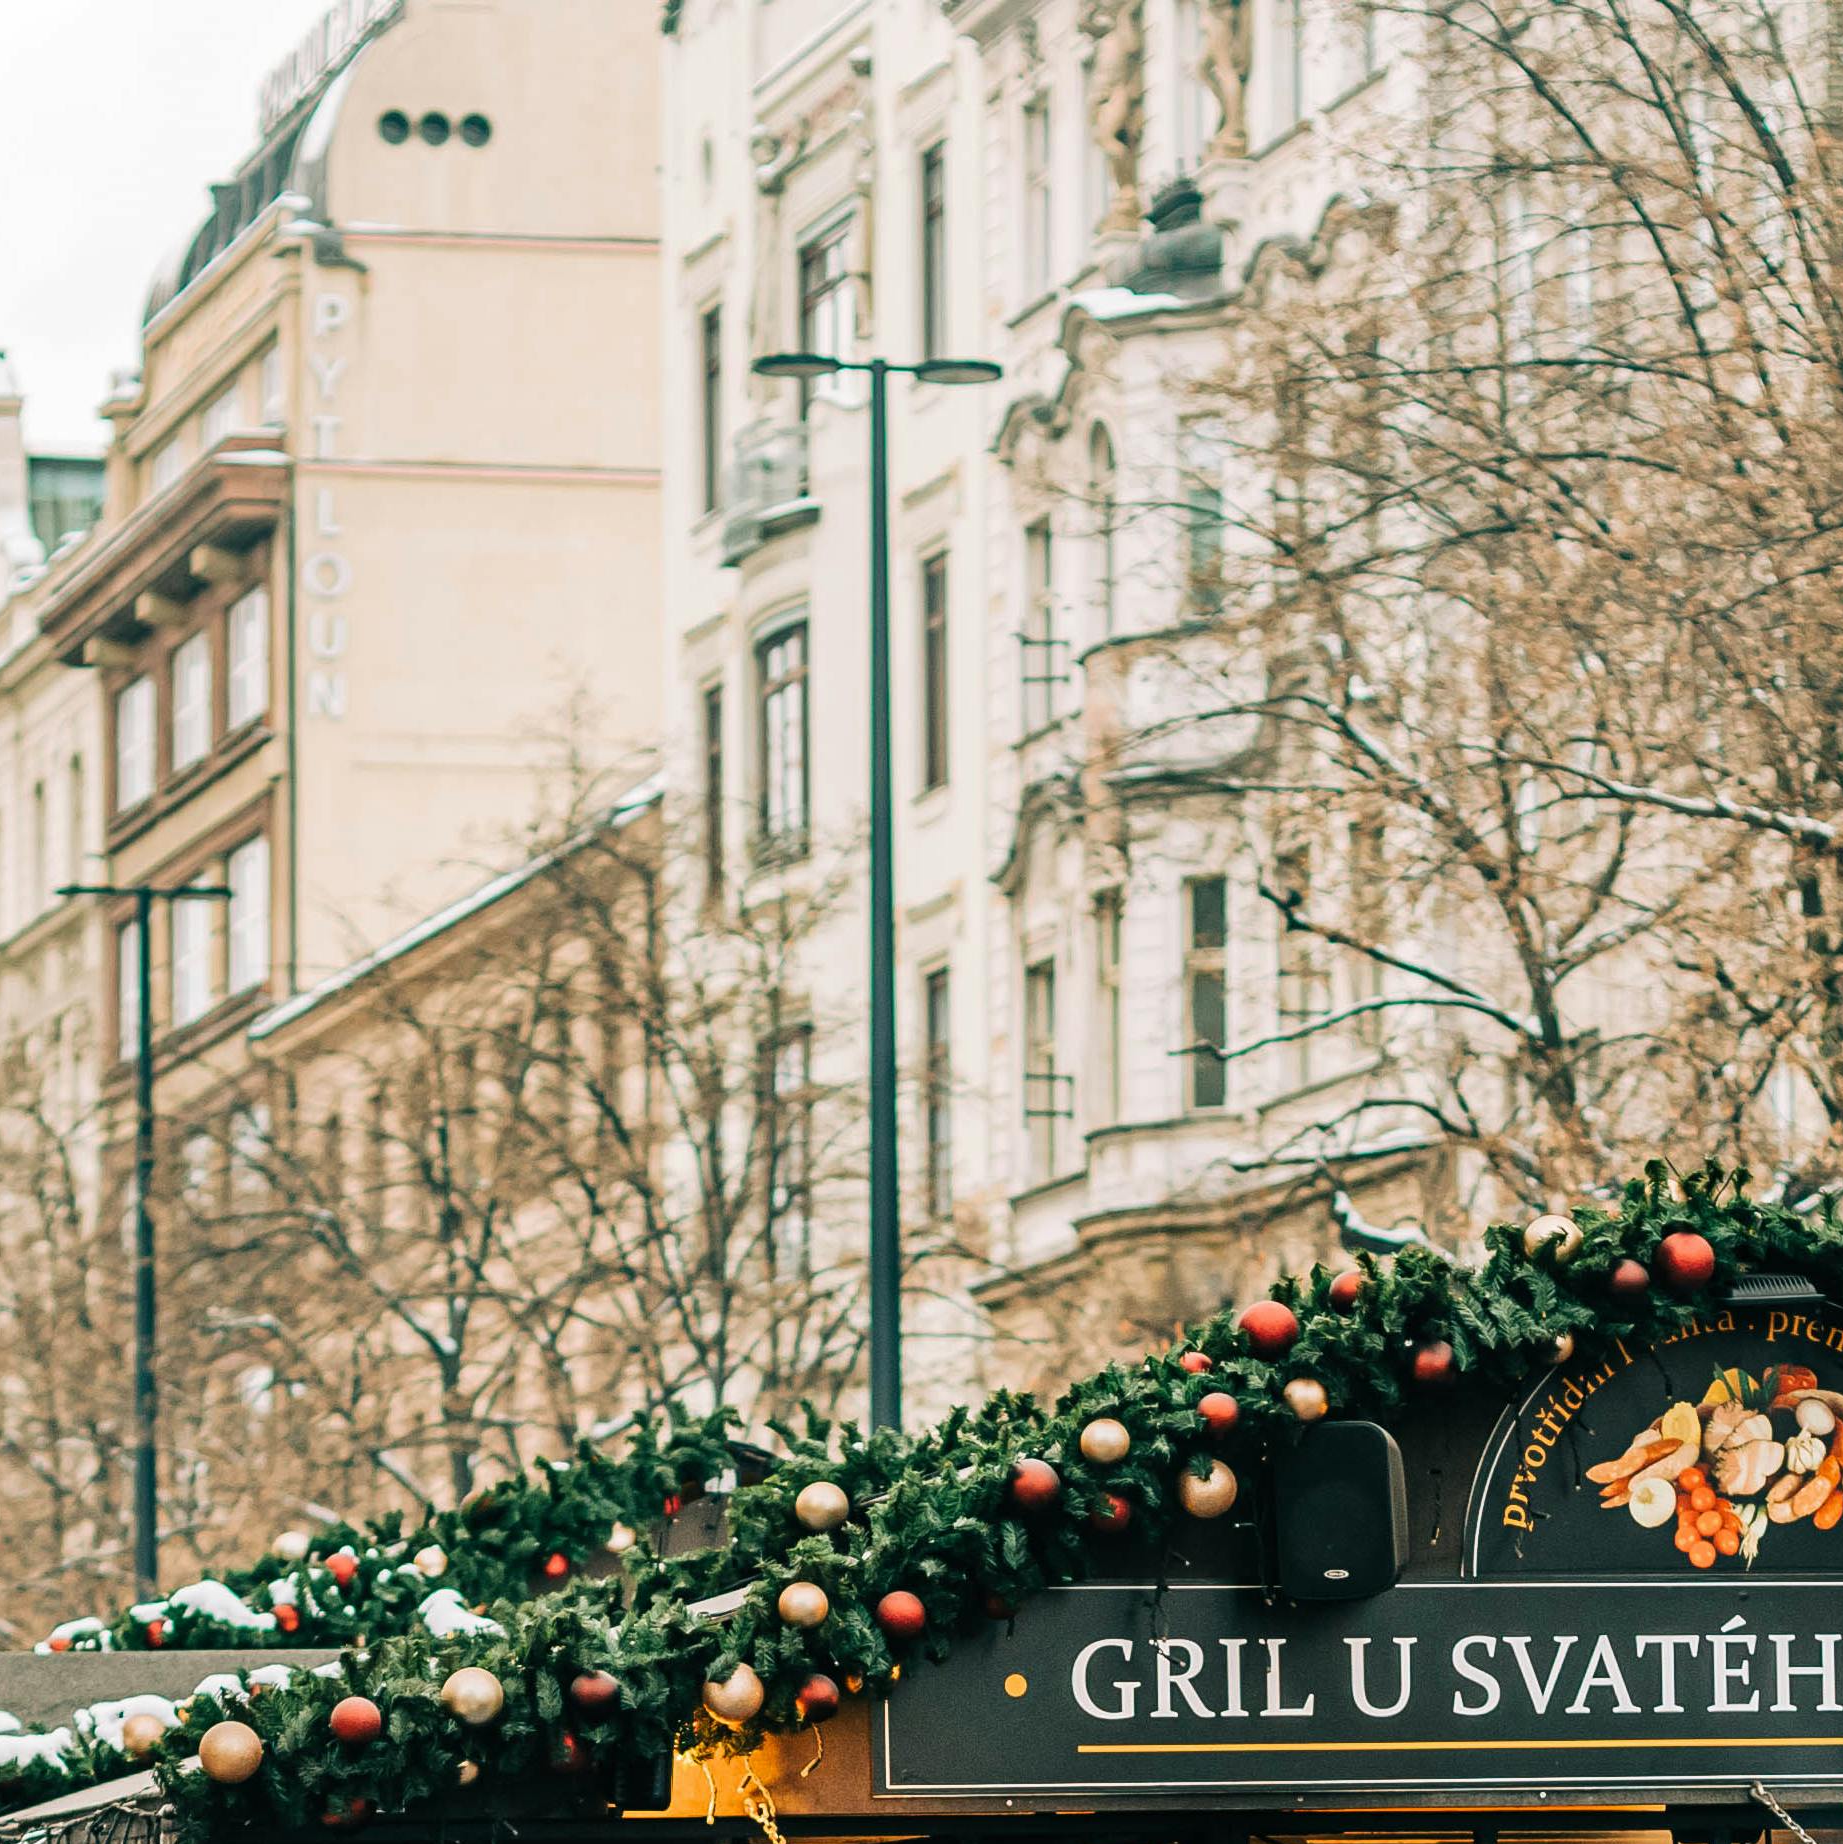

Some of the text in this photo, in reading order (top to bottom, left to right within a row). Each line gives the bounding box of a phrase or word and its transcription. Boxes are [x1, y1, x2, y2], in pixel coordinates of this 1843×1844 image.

[302, 293, 353, 719] PYTLOUN
[1071, 1637, 1315, 1720] GRIL
[1343, 1636, 1418, 1718] U
